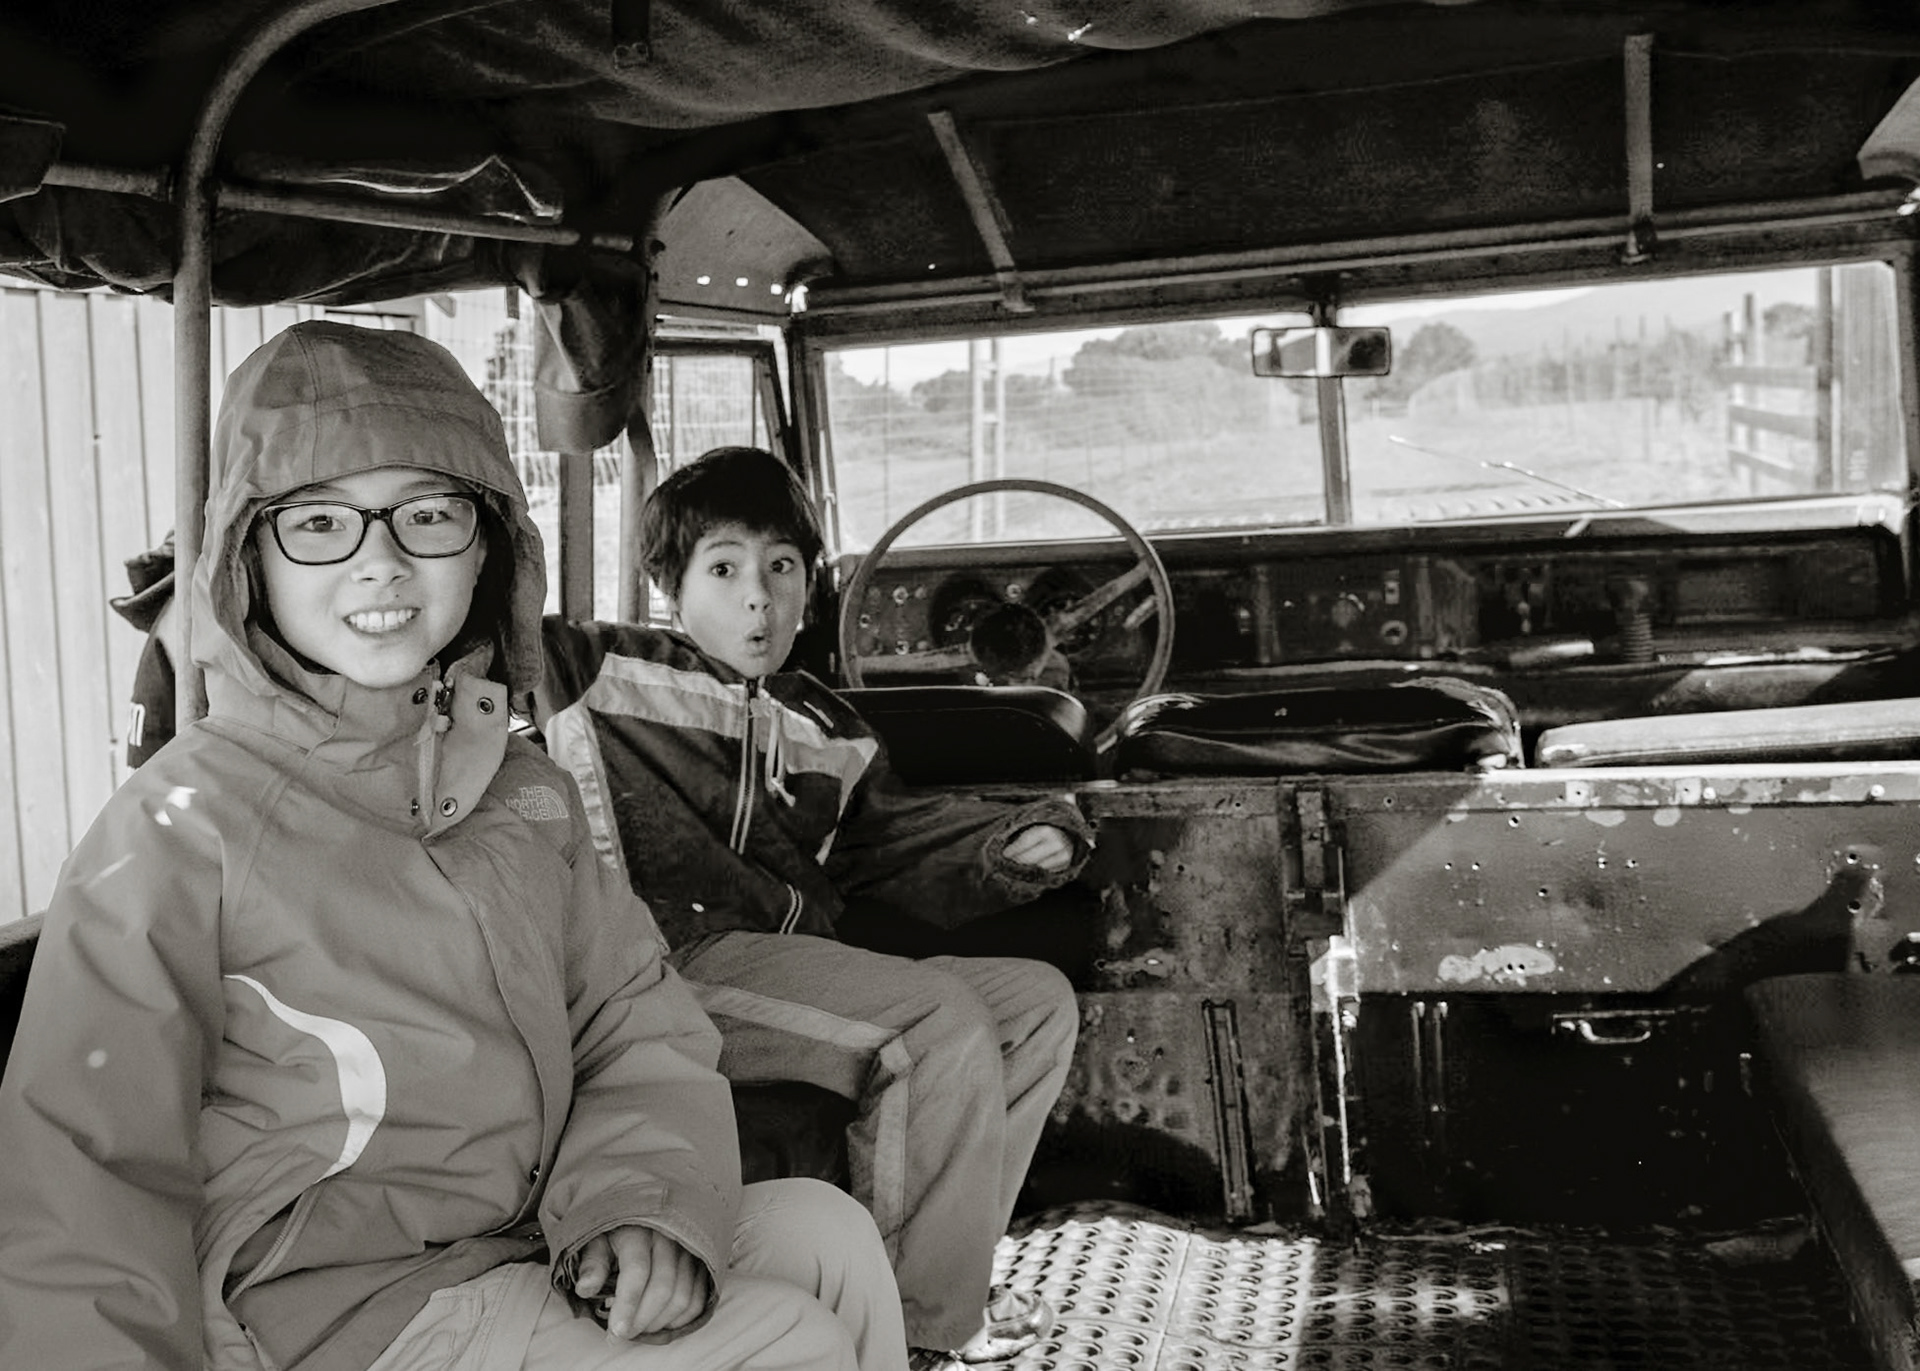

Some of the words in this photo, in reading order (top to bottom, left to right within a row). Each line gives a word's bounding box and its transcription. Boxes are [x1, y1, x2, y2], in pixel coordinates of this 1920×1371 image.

[519, 786, 544, 797] THE
[505, 796, 547, 809] NORTH
[520, 809, 549, 821] FACE
